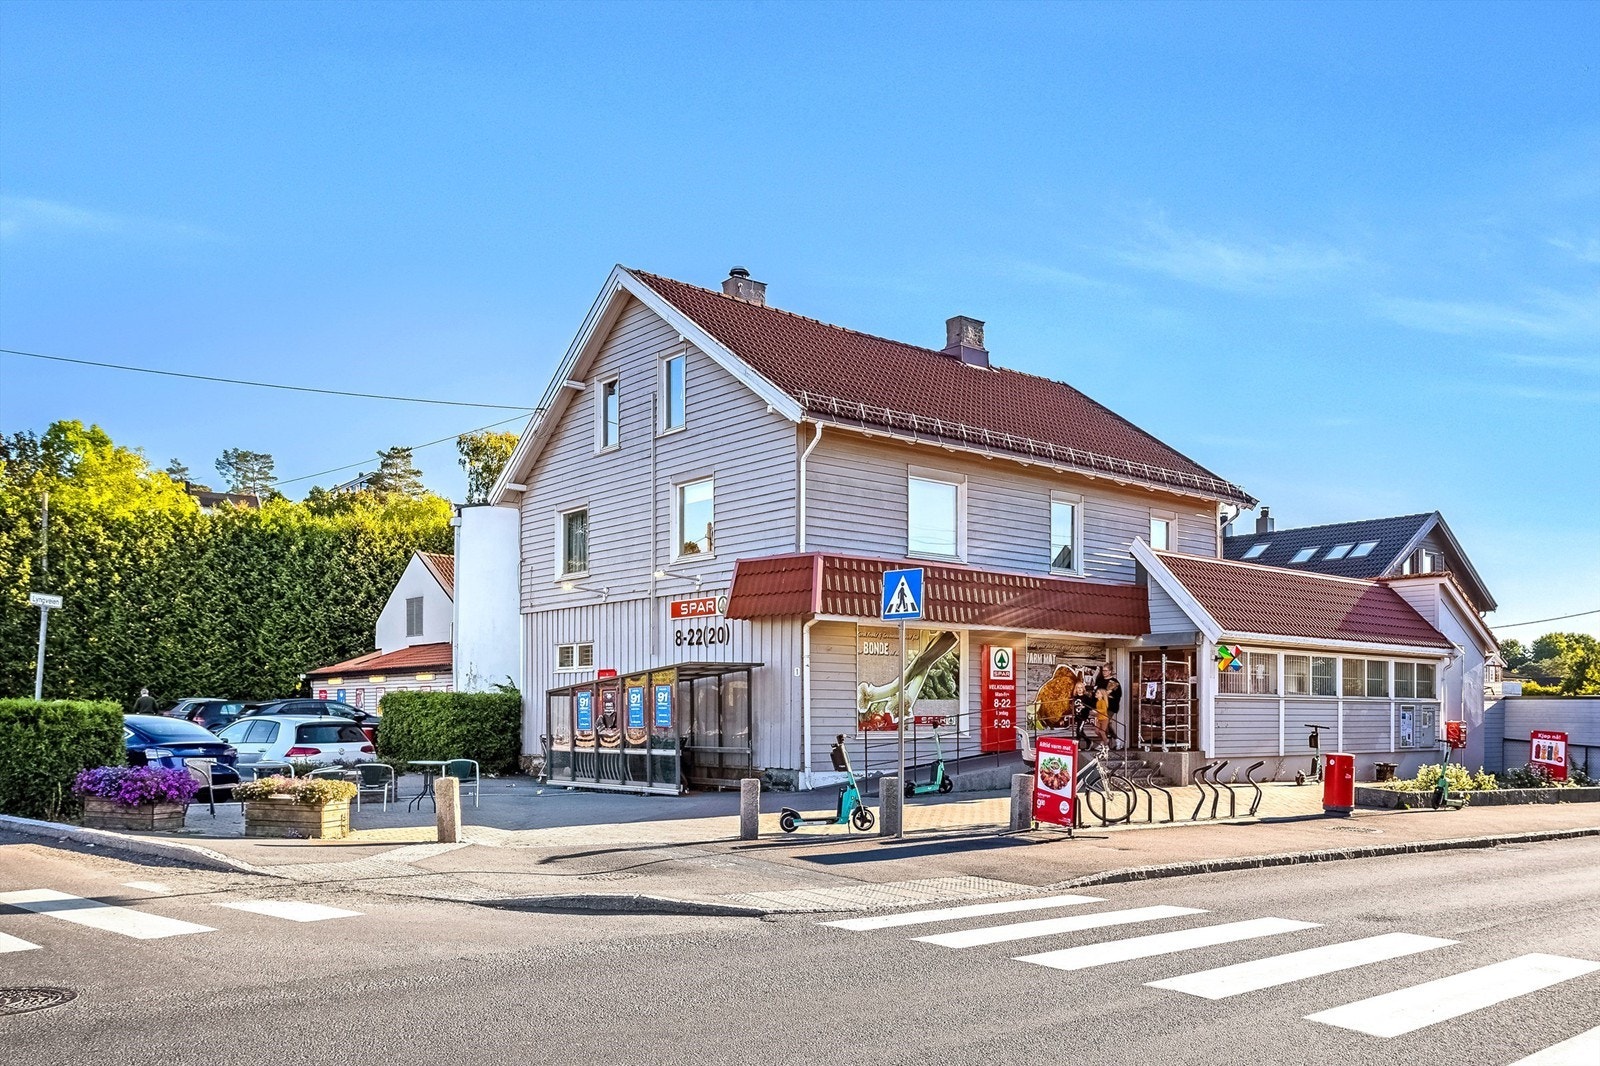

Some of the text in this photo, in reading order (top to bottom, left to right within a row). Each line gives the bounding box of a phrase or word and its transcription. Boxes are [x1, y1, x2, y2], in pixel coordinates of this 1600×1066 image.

[32, 595, 60, 605] Lyngveien
[680, 600, 715, 615] SPAR
[675, 622, 730, 648] 8-22(20)
[863, 641, 890, 656] BONDE
[579, 697, 589, 707] 91
[630, 693, 641, 704] 91
[657, 691, 668, 702] 91
[993, 698, 1011, 708] 8-22
[993, 719, 1011, 729] 8-20
